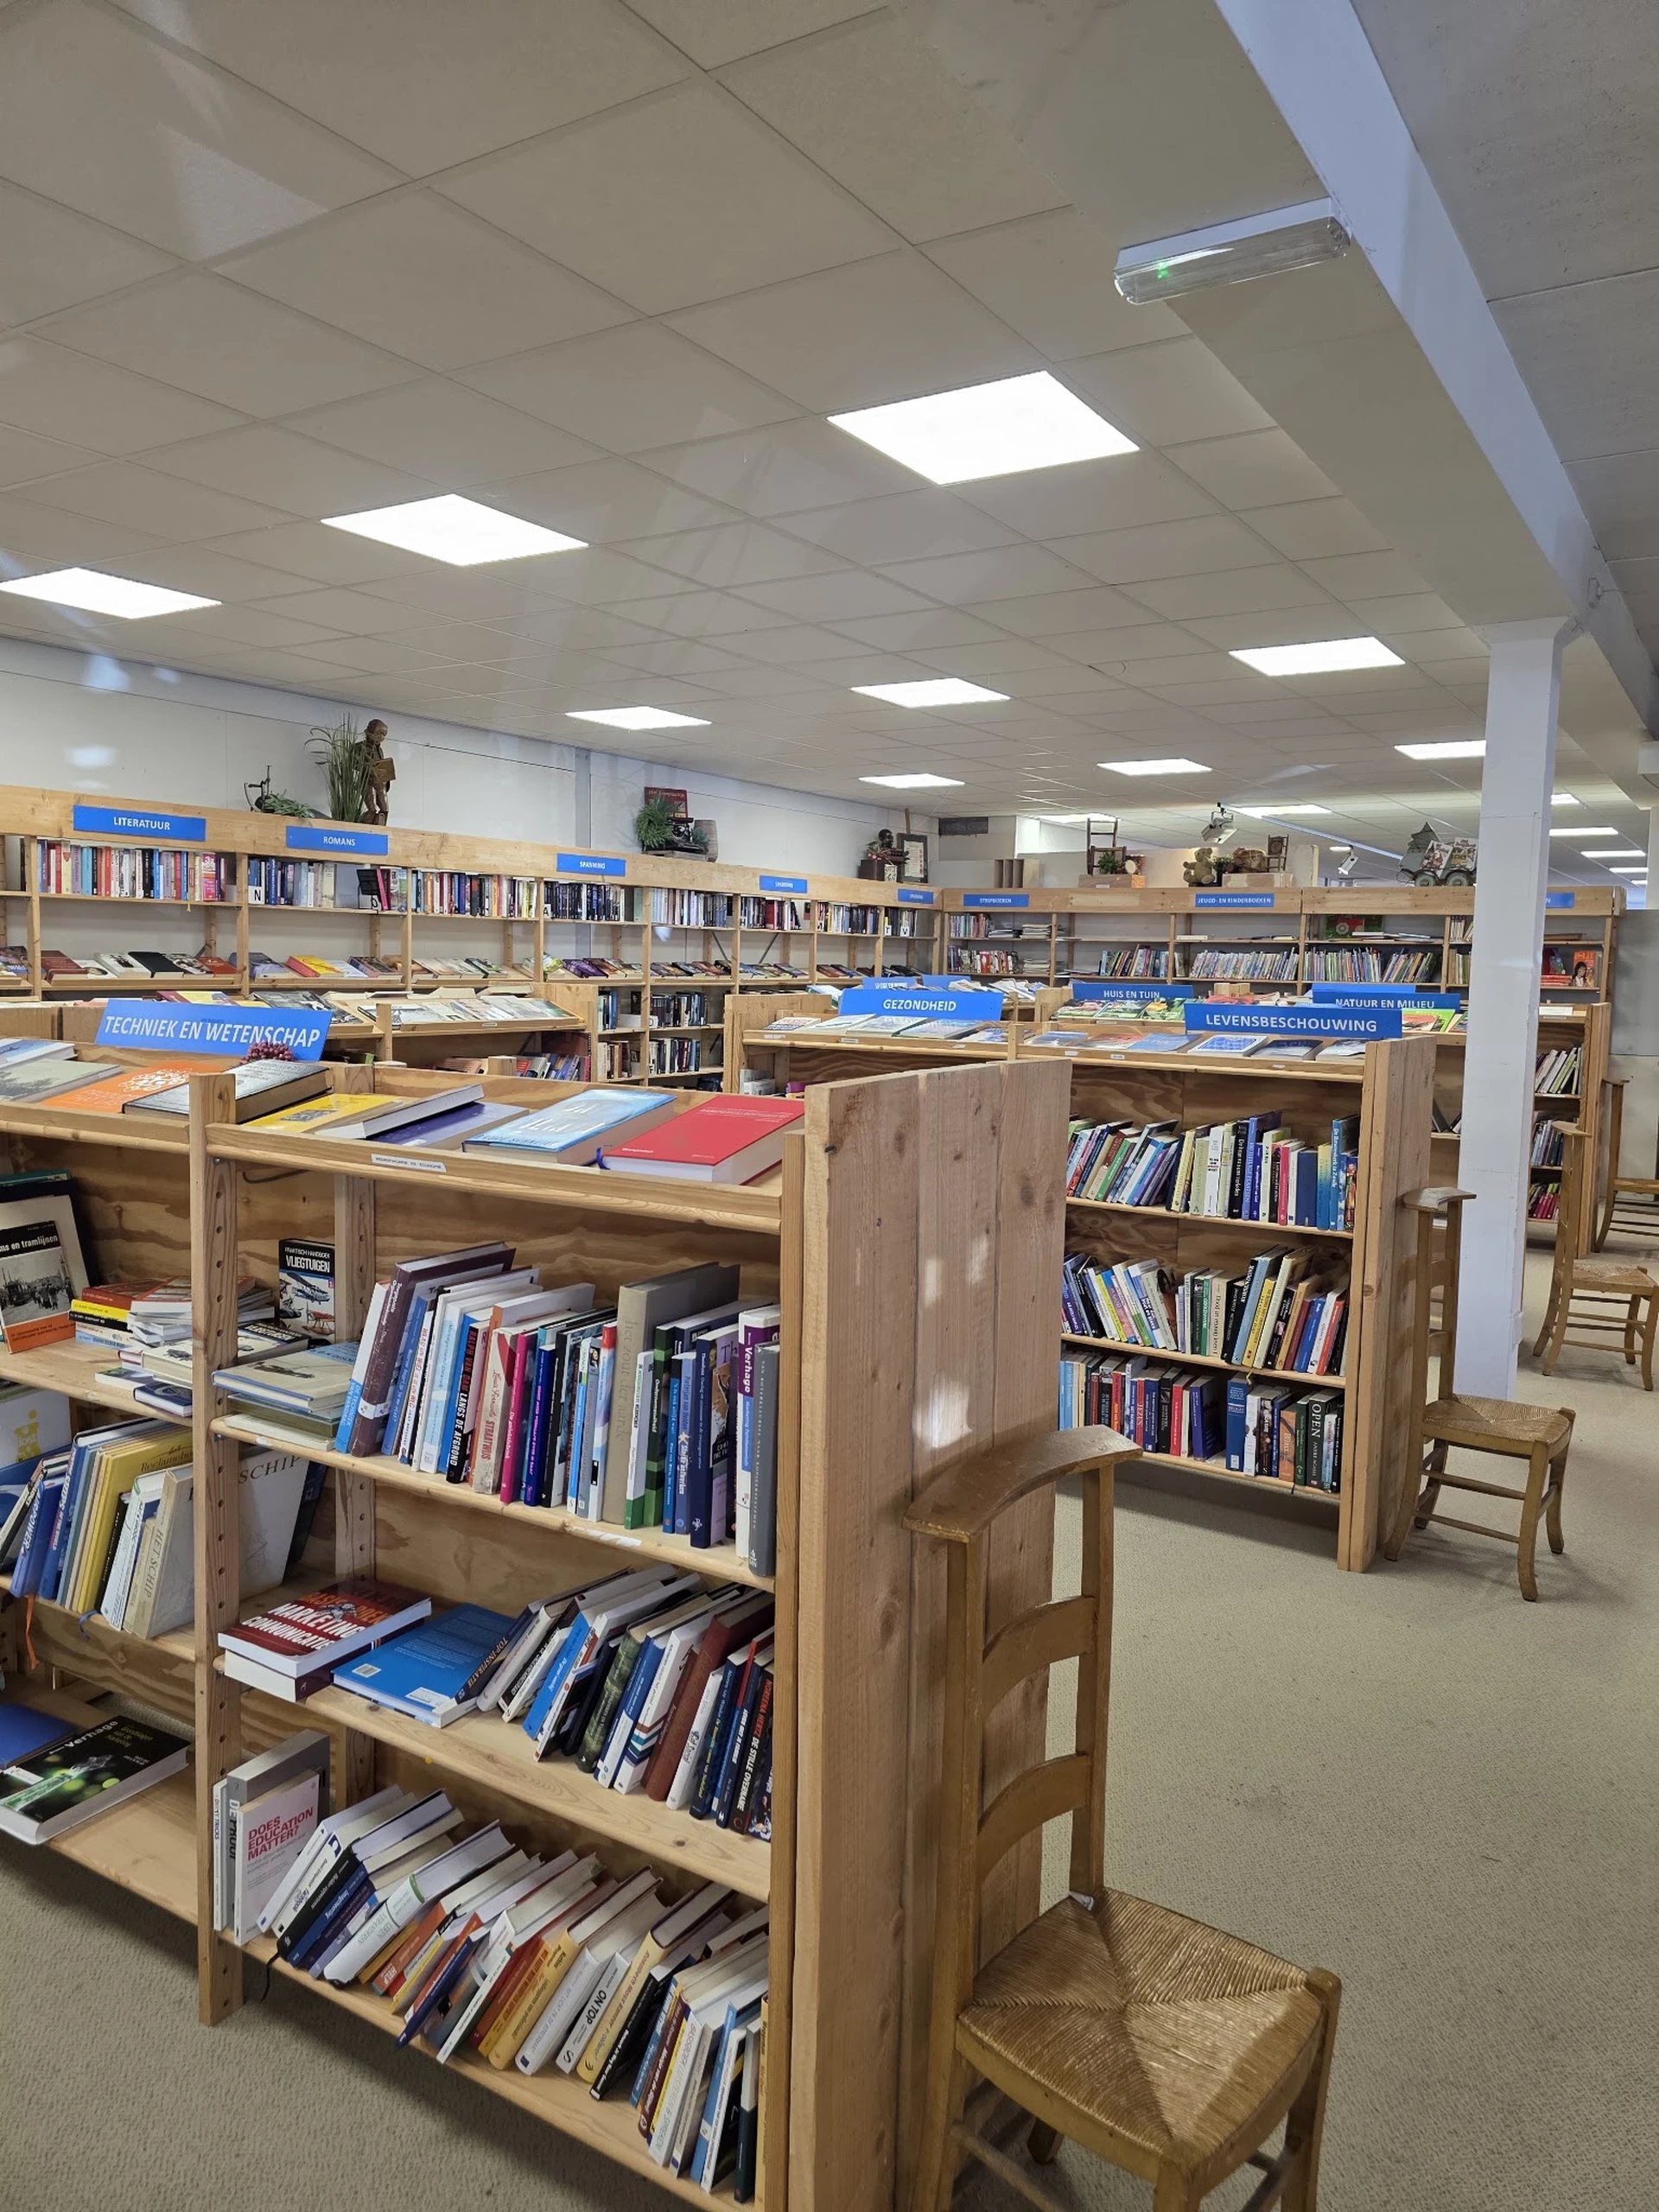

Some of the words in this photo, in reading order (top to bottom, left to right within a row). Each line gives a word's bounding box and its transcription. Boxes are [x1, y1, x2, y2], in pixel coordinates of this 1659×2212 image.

[113, 817, 170, 830] LITERATUUR
[323, 836, 356, 847] ROMANS
[883, 999, 957, 1012] GEZONDHEID
[1336, 998, 1378, 1008] NATUUR
[1381, 999, 1394, 1008] EN
[1397, 999, 1434, 1009] MILIEU
[105, 1015, 179, 1038] TECHNIEK
[179, 1021, 200, 1039] EN
[205, 1021, 321, 1048] WETENSCHAP
[1205, 1014, 1377, 1033] LEVENSBESCHOUWING
[21, 1235, 59, 1249] tramlijnen
[285, 1255, 330, 1273] VLIEGTUIGEN
[466, 1330, 477, 1355] RALPH
[463, 1356, 474, 1372] VAN
[461, 1373, 471, 1392] DAM
[618, 1378, 632, 1402] der
[339, 1395, 353, 1427] VANDAAG
[345, 1395, 359, 1426] TECHNIEK
[456, 1392, 468, 1418] LANGS
[508, 1411, 515, 1421] De
[454, 1418, 464, 1429] DE
[614, 1404, 631, 1443] aarde
[1309, 1402, 1322, 1438] OPEN
[449, 1429, 463, 1466] AFGROND
[480, 1420, 495, 1461] STRAATWIJS
[238, 1455, 301, 1484] SCHIP
[57, 1473, 71, 1510] SHIPS
[22, 1488, 42, 1549] AIRPOWER
[51, 1533, 60, 1551] WORLD
[151, 1528, 165, 1559] HET
[142, 1557, 159, 1599] SCHIP
[242, 1616, 336, 1650] COMMUNICATIE
[268, 1603, 366, 1638] MARKETING
[467, 1637, 508, 1688] TOP-INSPIRATIE
[758, 1678, 773, 1713] NOREENA
[65, 1720, 118, 1748] Verhage
[753, 1713, 766, 1738] HERTZ
[749, 1736, 760, 1750] DE
[745, 1747, 758, 1771] STILLE
[735, 1770, 753, 1812] OVERNAME
[228, 1798, 239, 1818] DE
[248, 1807, 314, 1852] EDUCATION
[249, 1816, 281, 1840] DOES
[247, 1826, 299, 1861] MATTER?
[594, 1988, 607, 2007] ON
[620, 1984, 632, 2005] Moss
[583, 2004, 598, 2025] TOP
[607, 2002, 623, 2029] Kanter
